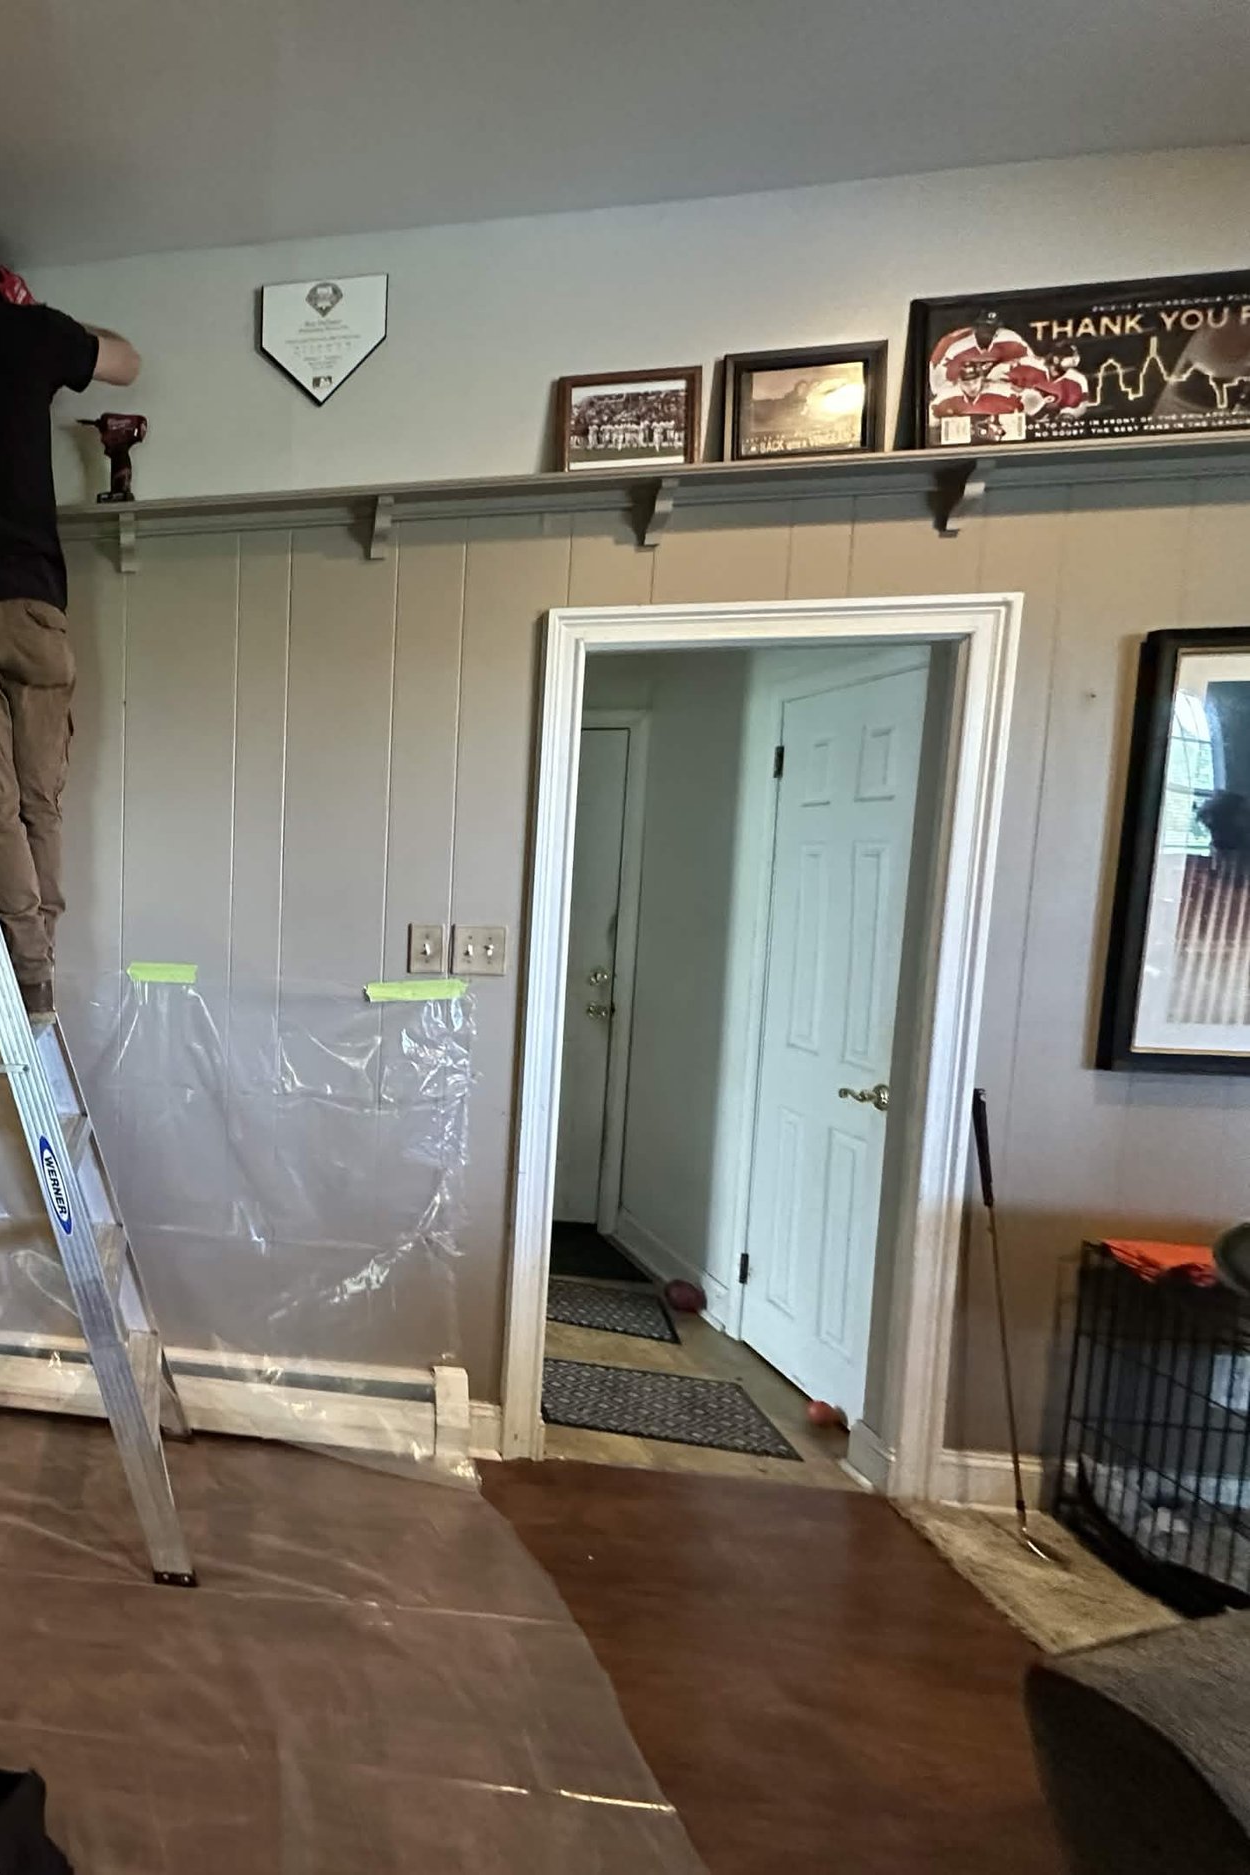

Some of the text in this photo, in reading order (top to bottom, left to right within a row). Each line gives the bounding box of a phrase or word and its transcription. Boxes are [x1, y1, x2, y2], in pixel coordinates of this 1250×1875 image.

[1137, 295, 1223, 310] PHILADELPHIA
[1029, 313, 1146, 342] THANK
[1160, 307, 1230, 332] YOU
[1061, 420, 1086, 428] PLAY
[1103, 417, 1136, 426] FRONT
[1114, 425, 1139, 433] BEST
[759, 439, 785, 454] BACK
[44, 1155, 68, 1216] WERNER
